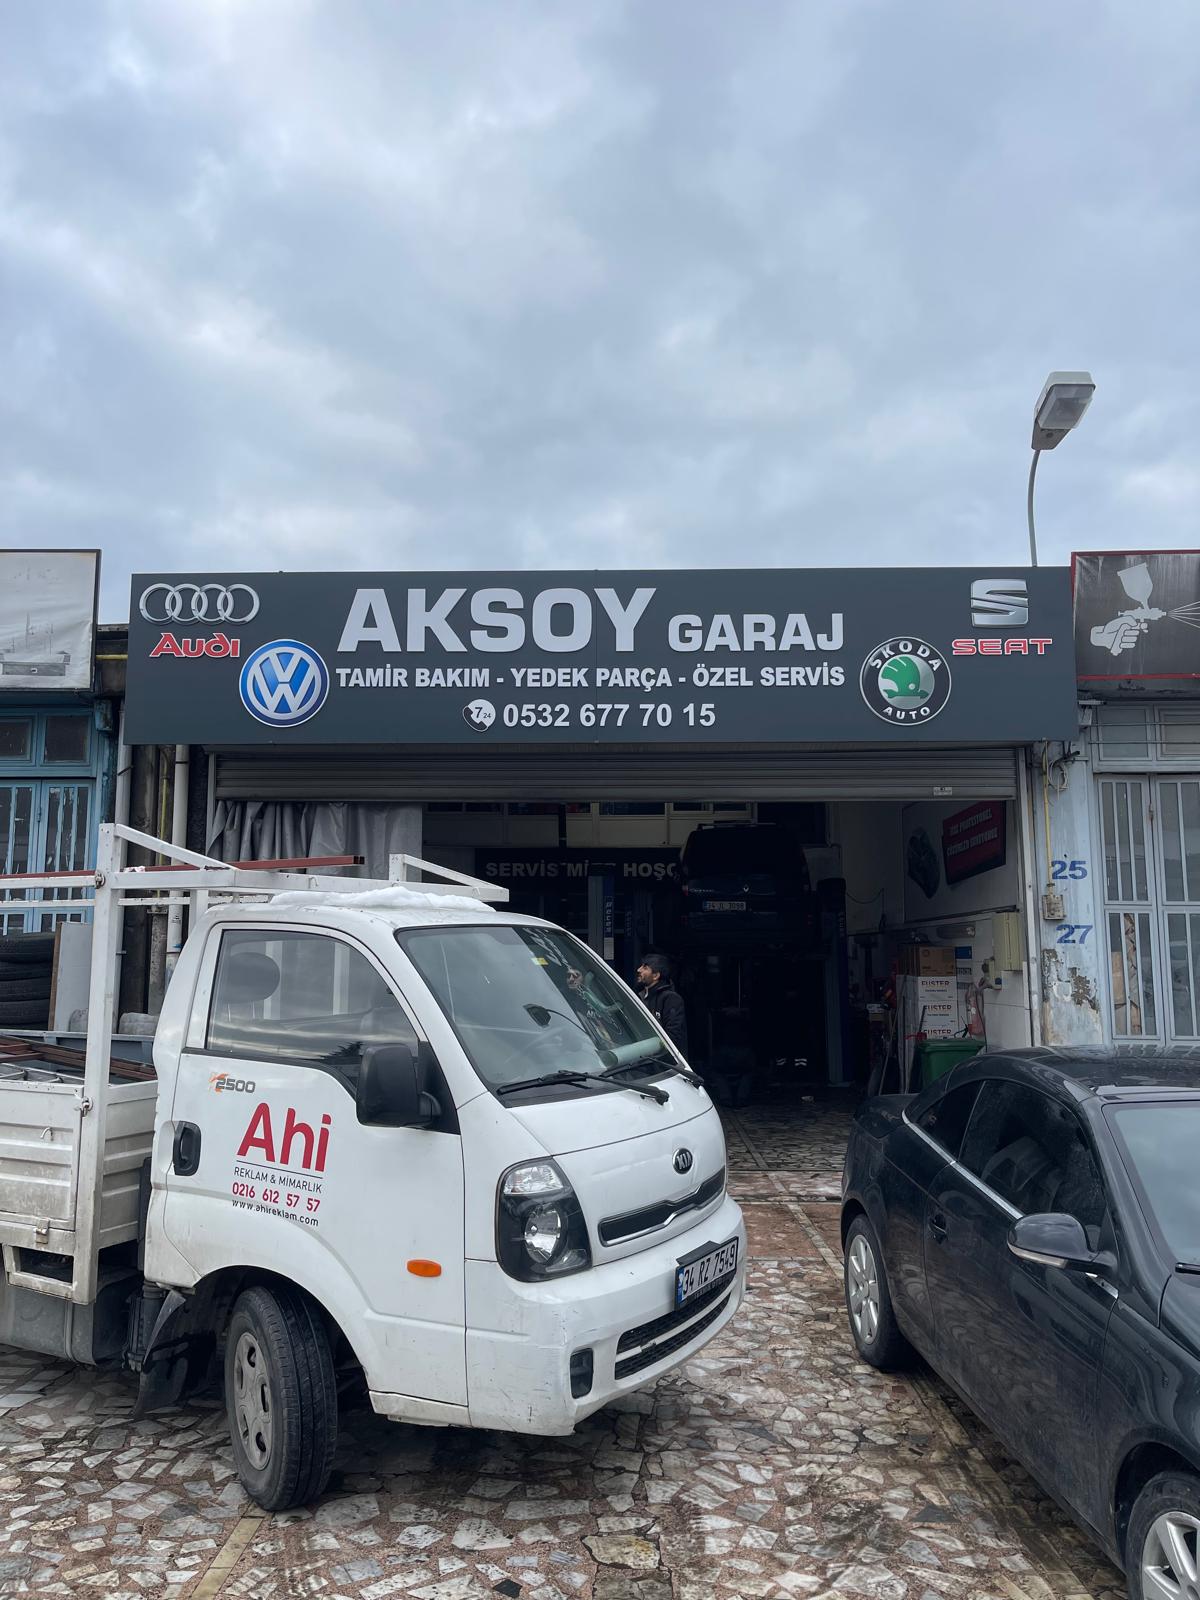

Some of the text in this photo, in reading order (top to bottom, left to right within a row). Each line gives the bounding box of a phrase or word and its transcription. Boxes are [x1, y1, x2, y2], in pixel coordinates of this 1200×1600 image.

[337, 587, 844, 653] AKSOY GARAJ
[149, 632, 241, 658] Audi
[869, 640, 942, 671] SKODA
[951, 638, 1053, 656] SEAT
[335, 664, 408, 687] TAMİR
[415, 668, 490, 688] BAKIM
[511, 667, 589, 687] YEDEK
[596, 667, 673, 692] PARÇA
[692, 663, 754, 687] ÖZEL
[760, 662, 845, 687] SERVİS
[503, 703, 716, 727] 0532 677 70 15
[883, 706, 930, 719] AUTO
[1051, 860, 1088, 880] 25
[1056, 924, 1093, 944] 27
[216, 1078, 256, 1093] 2500
[237, 1102, 332, 1172] Ahi
[234, 1166, 322, 1194] REKLAM & MİMARLIK
[232, 1181, 321, 1213] 0216 612 57 57
[232, 1199, 319, 1227] www.ahireklam.com
[682, 1266, 694, 1295] 34
[698, 1257, 711, 1287] RZ
[713, 1244, 736, 1278] 7549
